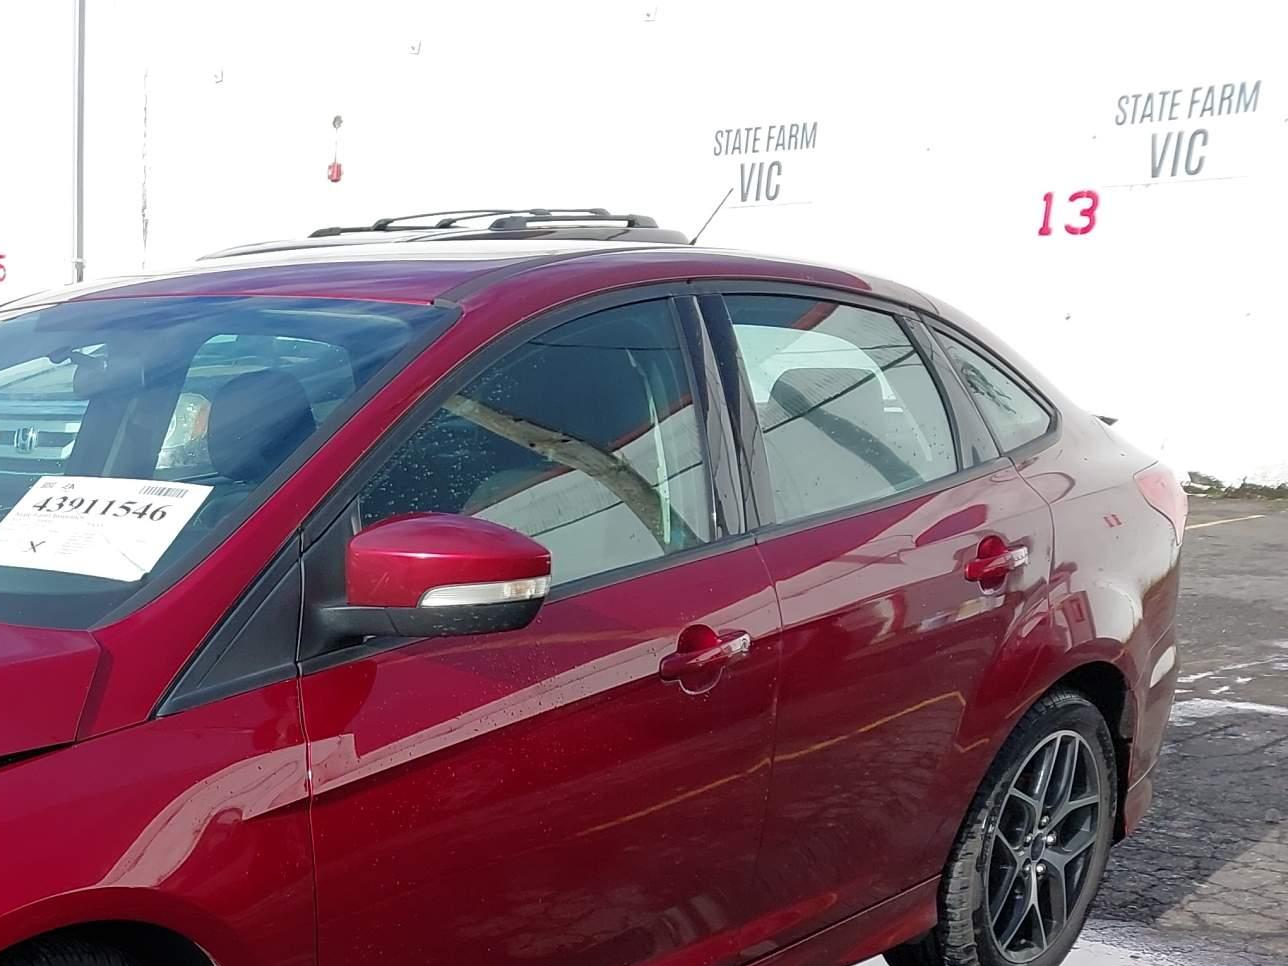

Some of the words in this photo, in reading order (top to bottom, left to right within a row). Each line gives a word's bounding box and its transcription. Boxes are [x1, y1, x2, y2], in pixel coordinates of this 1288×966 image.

[1115, 89, 1183, 125] STATE
[1187, 80, 1262, 119] FARM
[714, 126, 762, 156] STATE
[766, 121, 818, 152] FARM
[1150, 129, 1209, 178] VIC
[740, 160, 782, 202] VIC
[1038, 190, 1100, 236] 13
[32, 496, 173, 521] 43911546
